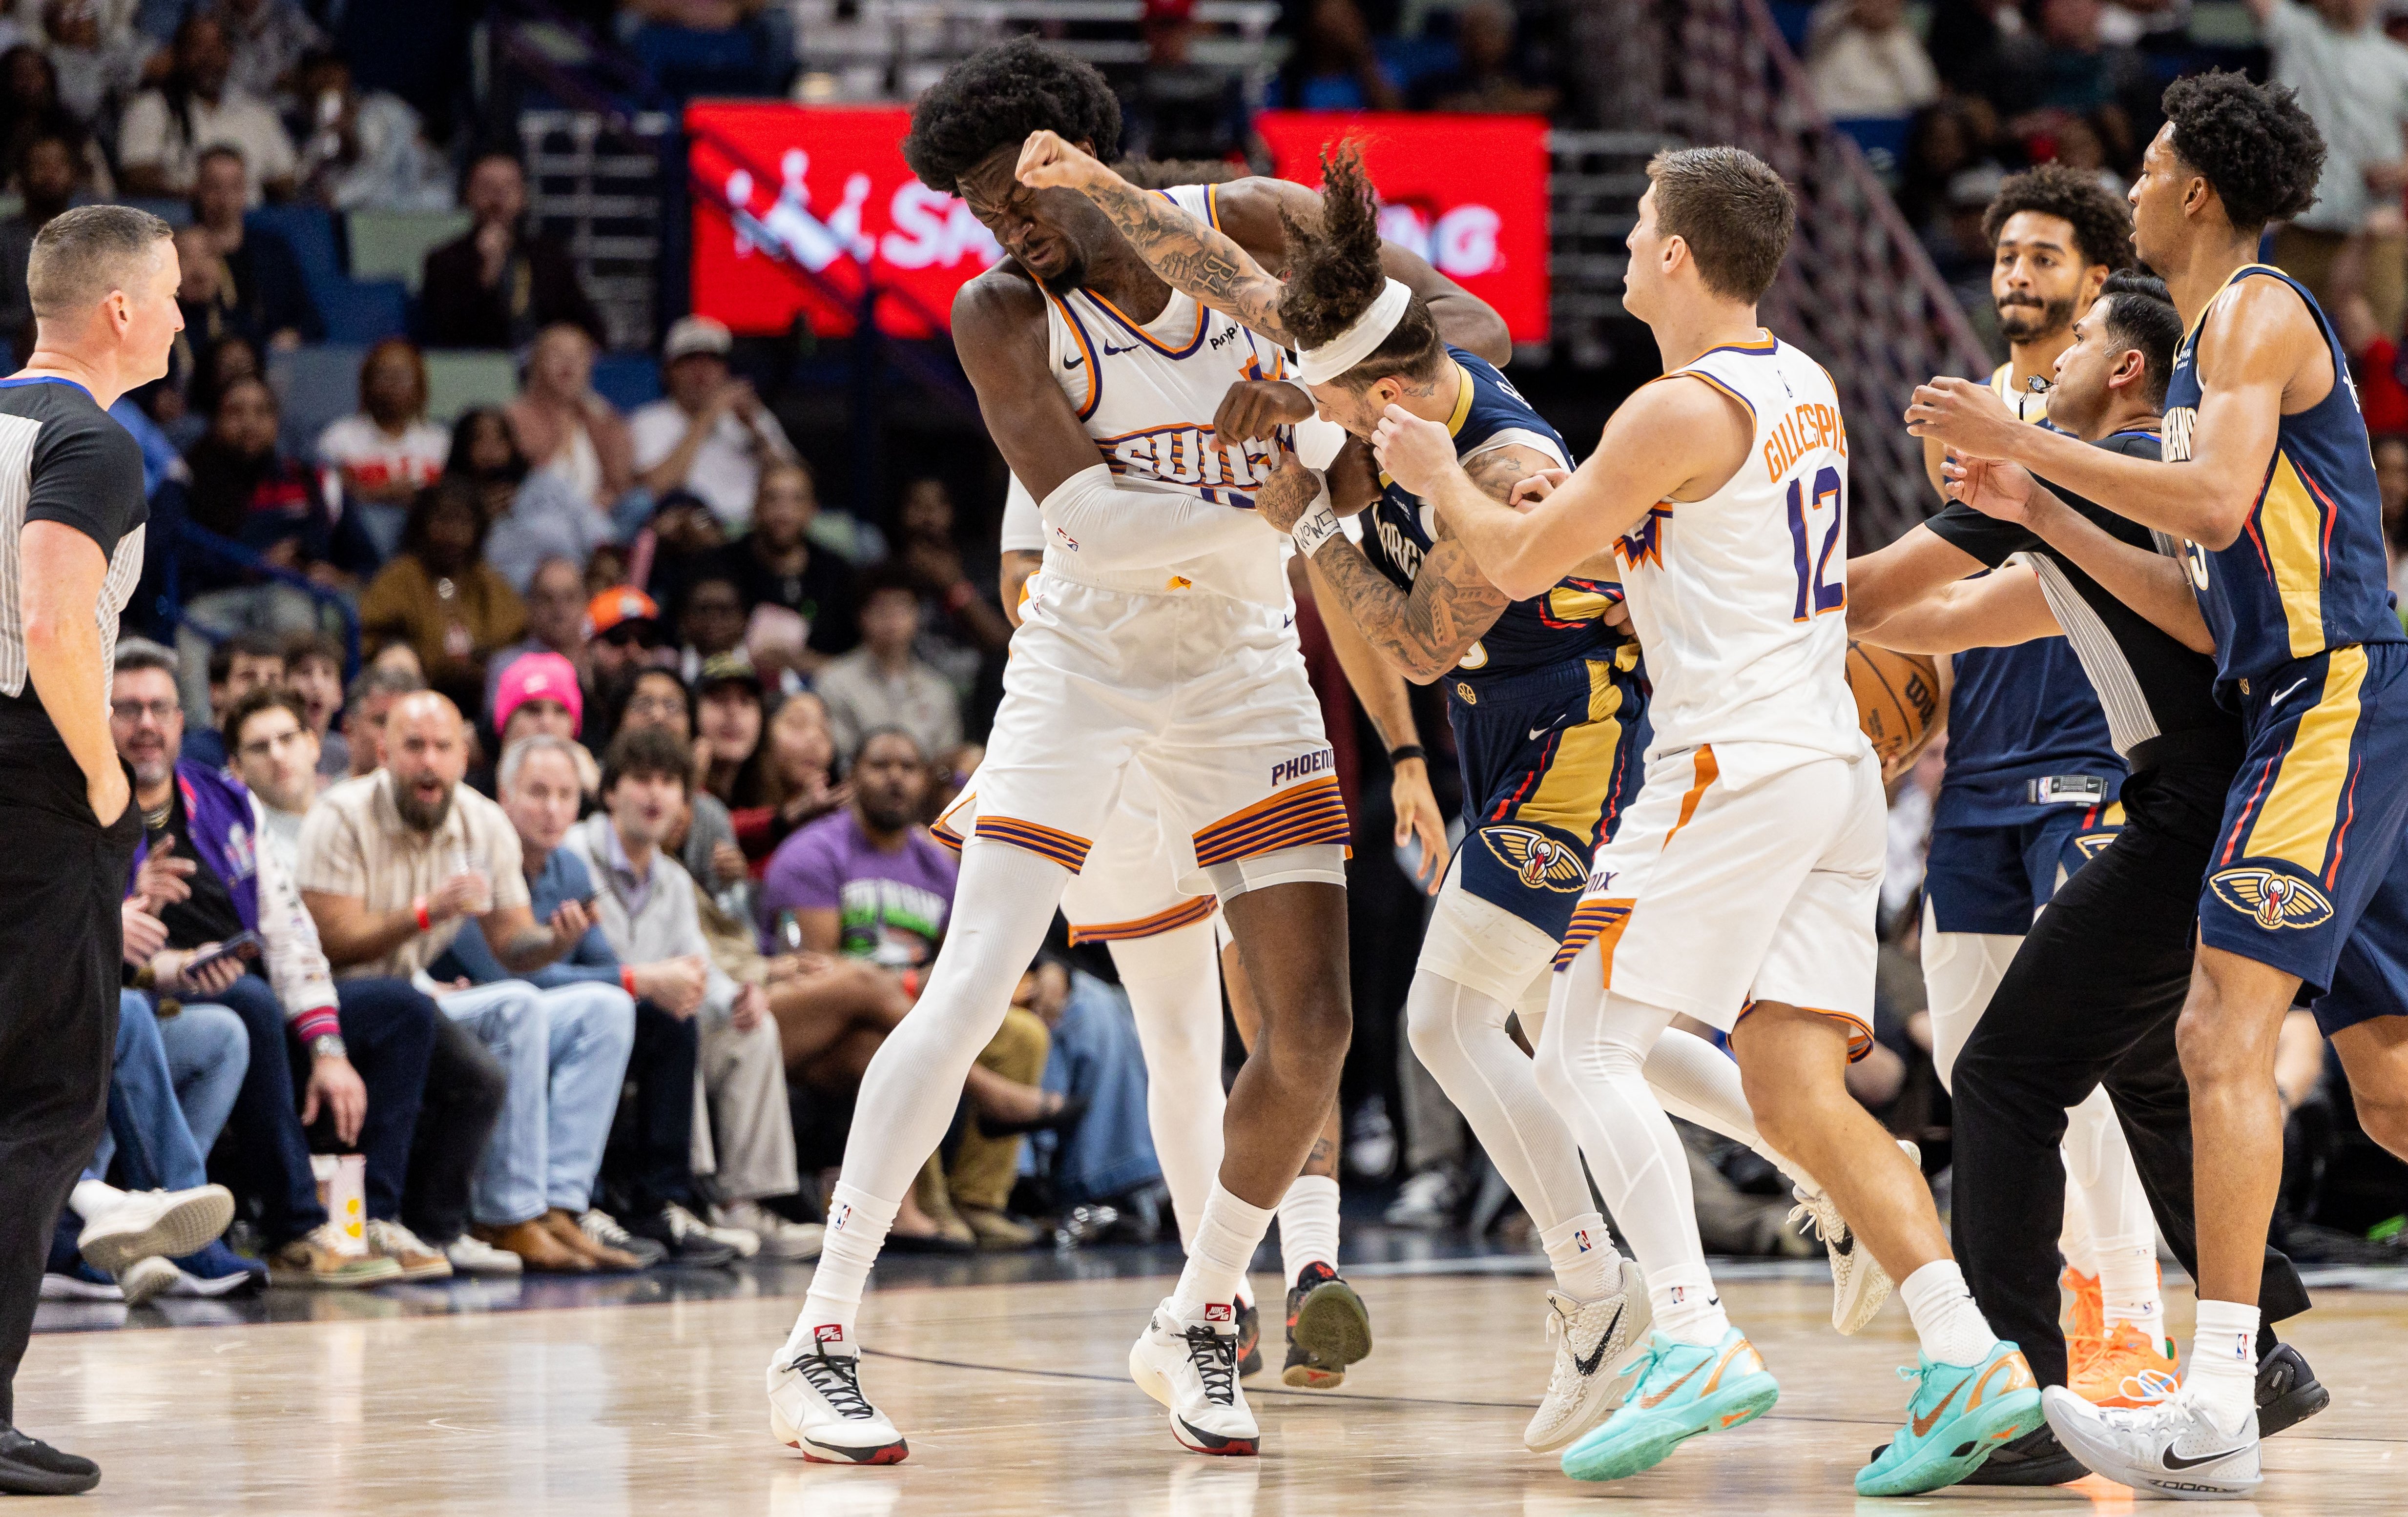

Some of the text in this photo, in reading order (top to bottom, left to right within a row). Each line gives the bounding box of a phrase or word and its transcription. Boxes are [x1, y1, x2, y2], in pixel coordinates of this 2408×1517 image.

[1764, 403, 1847, 483] GILLESPIE
[1786, 466, 1848, 623] 12
[1271, 748, 1335, 787] PHOENI
[1210, 1306, 1225, 1314] NIKE
